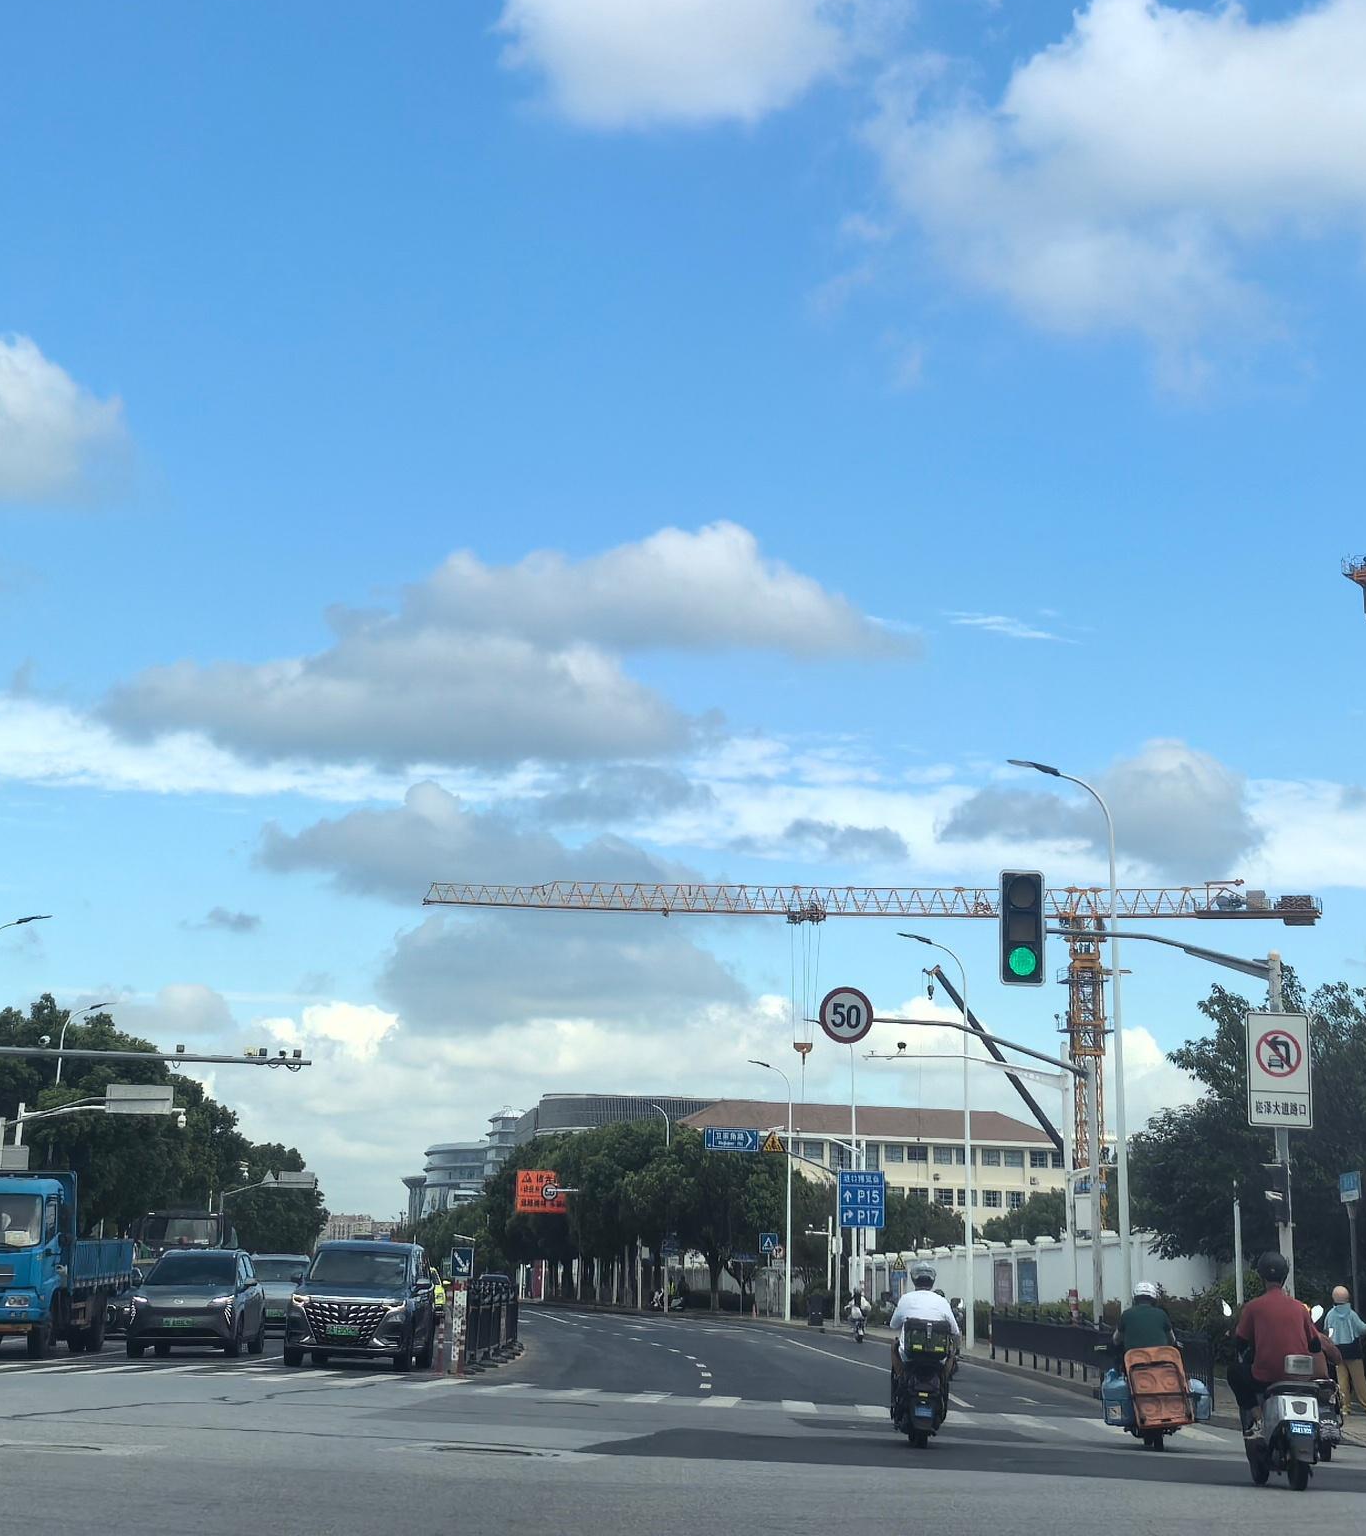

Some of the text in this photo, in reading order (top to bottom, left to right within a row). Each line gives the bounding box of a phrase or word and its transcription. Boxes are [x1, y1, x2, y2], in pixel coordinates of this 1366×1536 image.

[831, 1002, 861, 1029] 50
[857, 1189, 880, 1204] P15
[857, 1209, 880, 1225] P17
